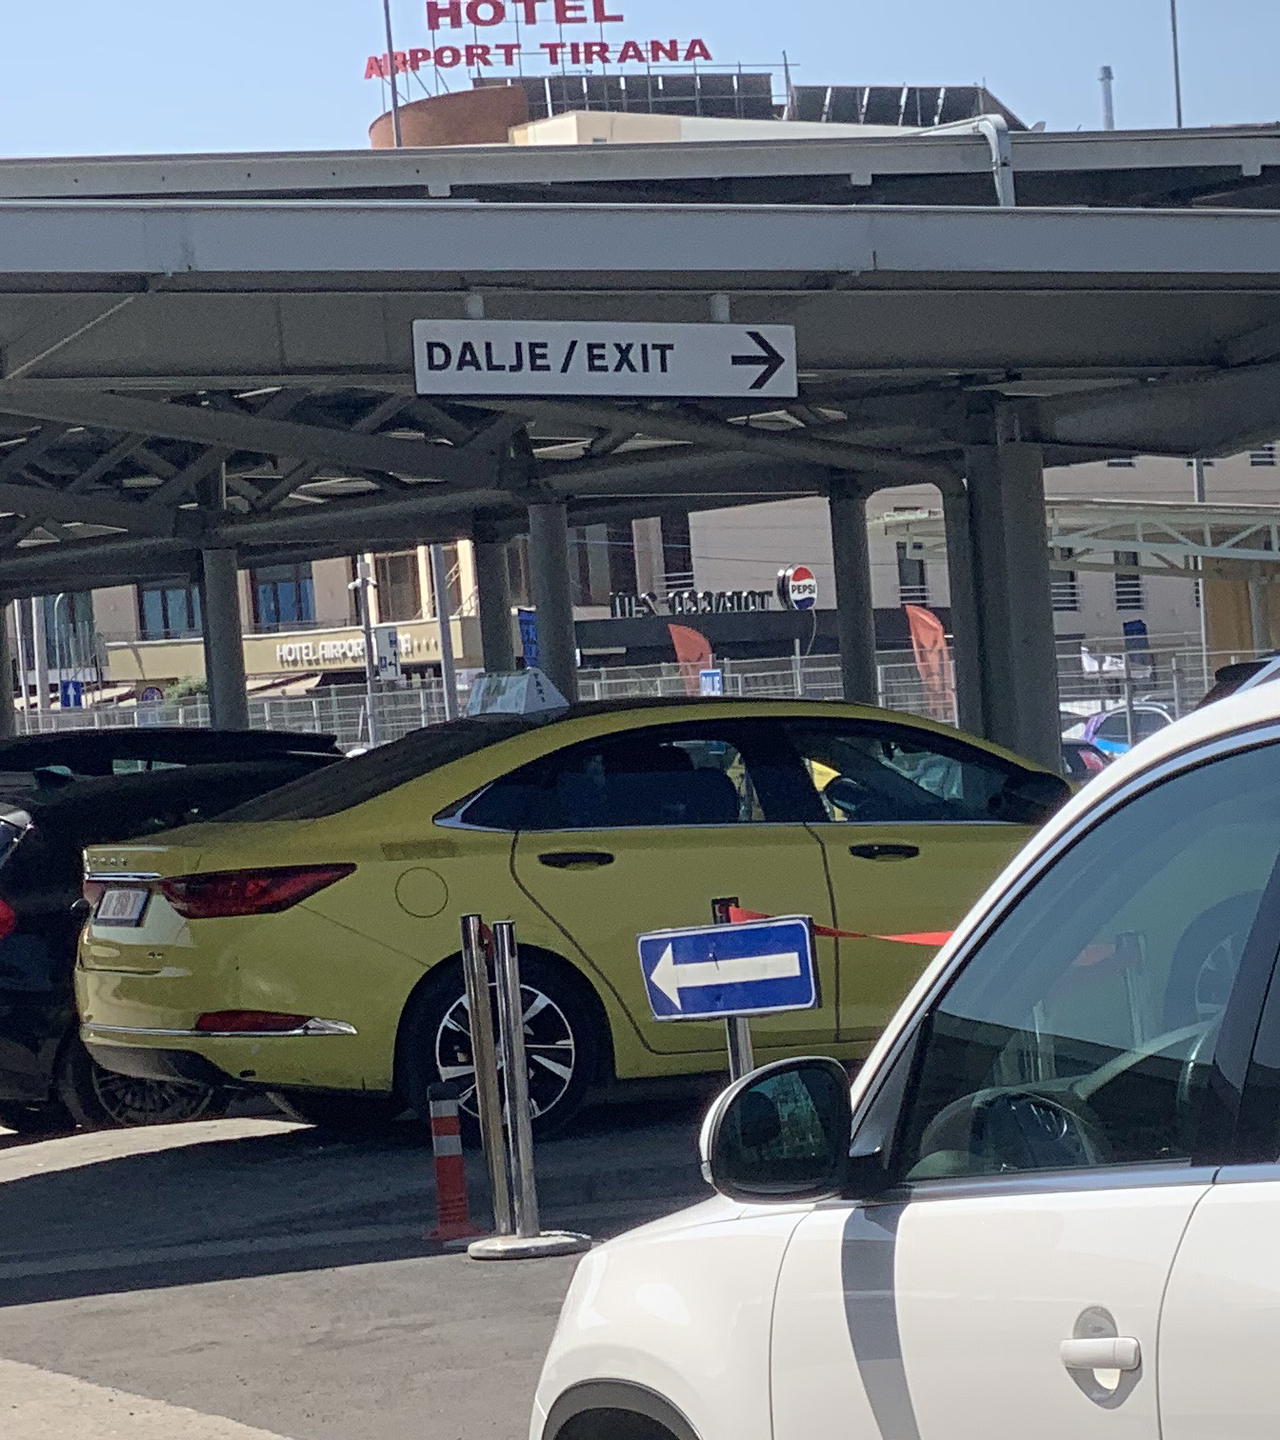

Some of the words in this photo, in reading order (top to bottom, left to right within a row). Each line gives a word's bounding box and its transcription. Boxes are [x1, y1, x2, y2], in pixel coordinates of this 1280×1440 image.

[427, 0, 624, 30] HOTEL
[364, 43, 522, 80] AIRPORT
[540, 38, 713, 65] TIRANA
[791, 584, 816, 595] PEPSI
[276, 640, 317, 661] HOTEL
